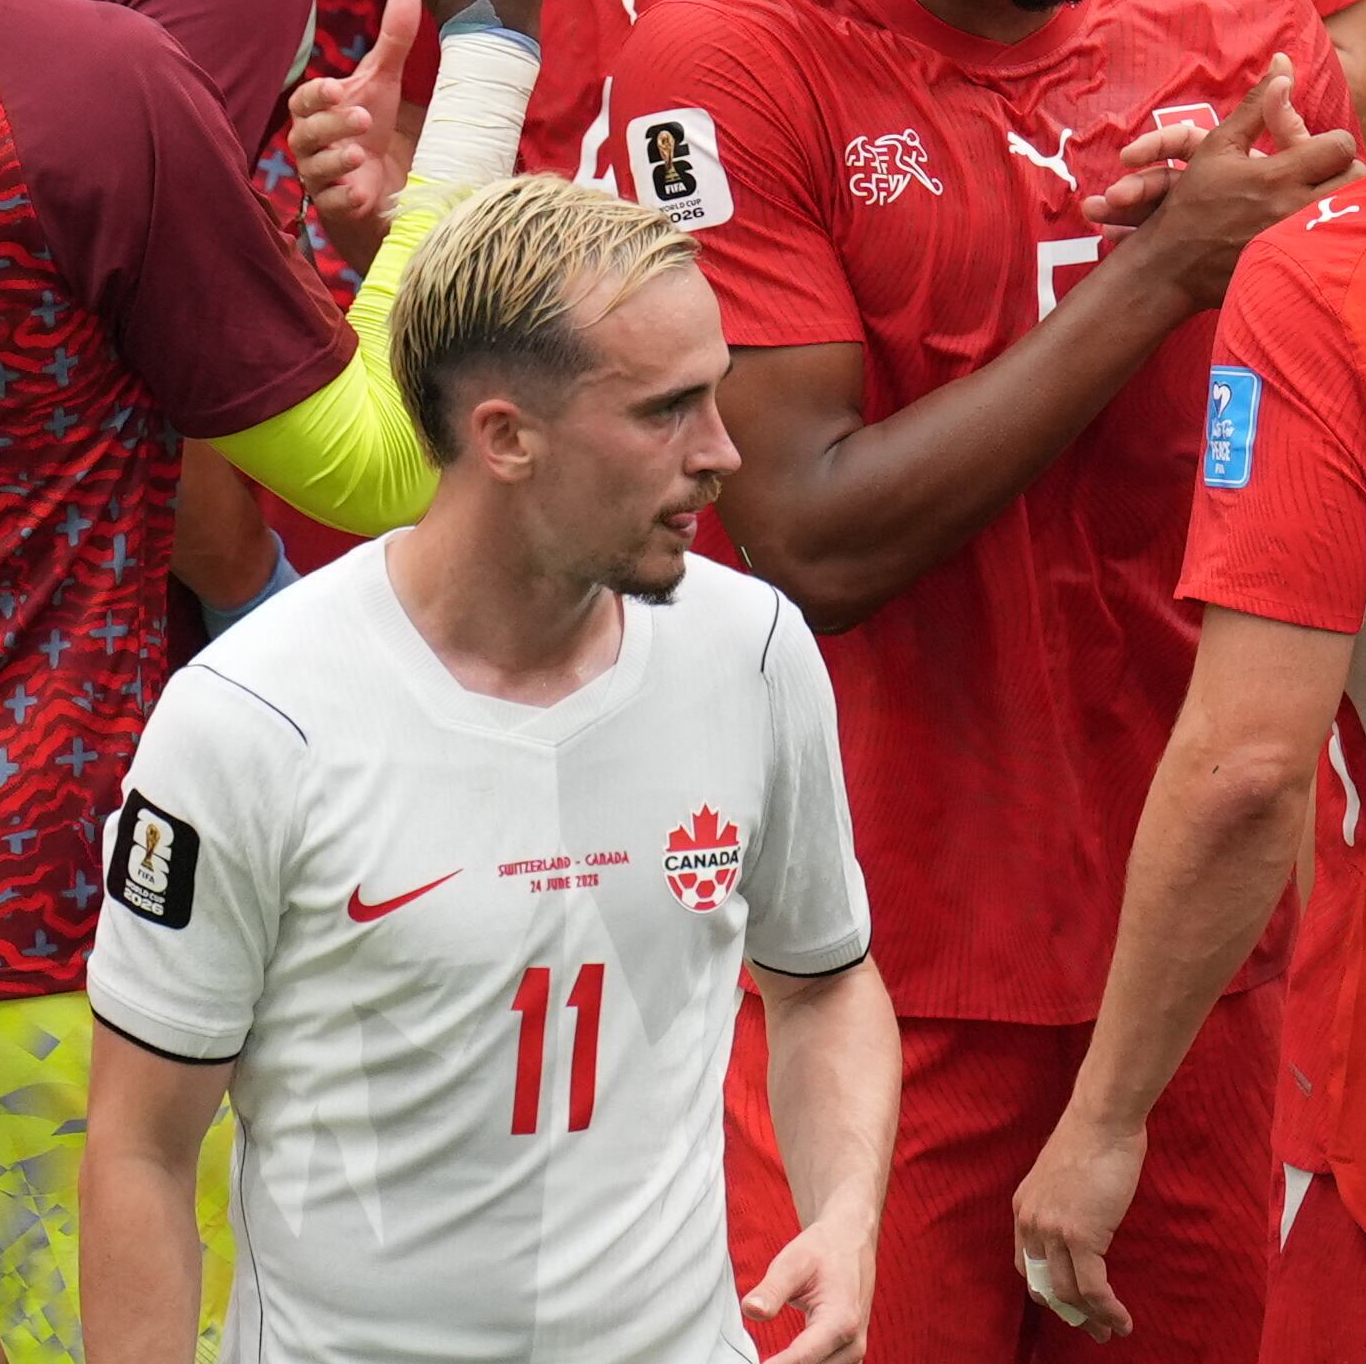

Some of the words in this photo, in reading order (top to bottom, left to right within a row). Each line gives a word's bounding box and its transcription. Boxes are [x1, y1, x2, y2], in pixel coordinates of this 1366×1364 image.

[665, 182, 687, 195] FIFA
[686, 198, 702, 208] CUP
[670, 207, 705, 223] 026
[498, 856, 571, 877] SWITZERLAND
[585, 851, 630, 867] CANADA
[664, 850, 740, 871] CANADA
[137, 869, 155, 884] FIFA
[530, 880, 542, 893] 24
[546, 877, 571, 891] JUNE
[576, 874, 599, 889] 2026
[125, 877, 149, 898] WORLD
[123, 886, 164, 916] 2026
[510, 963, 605, 1135] 11
